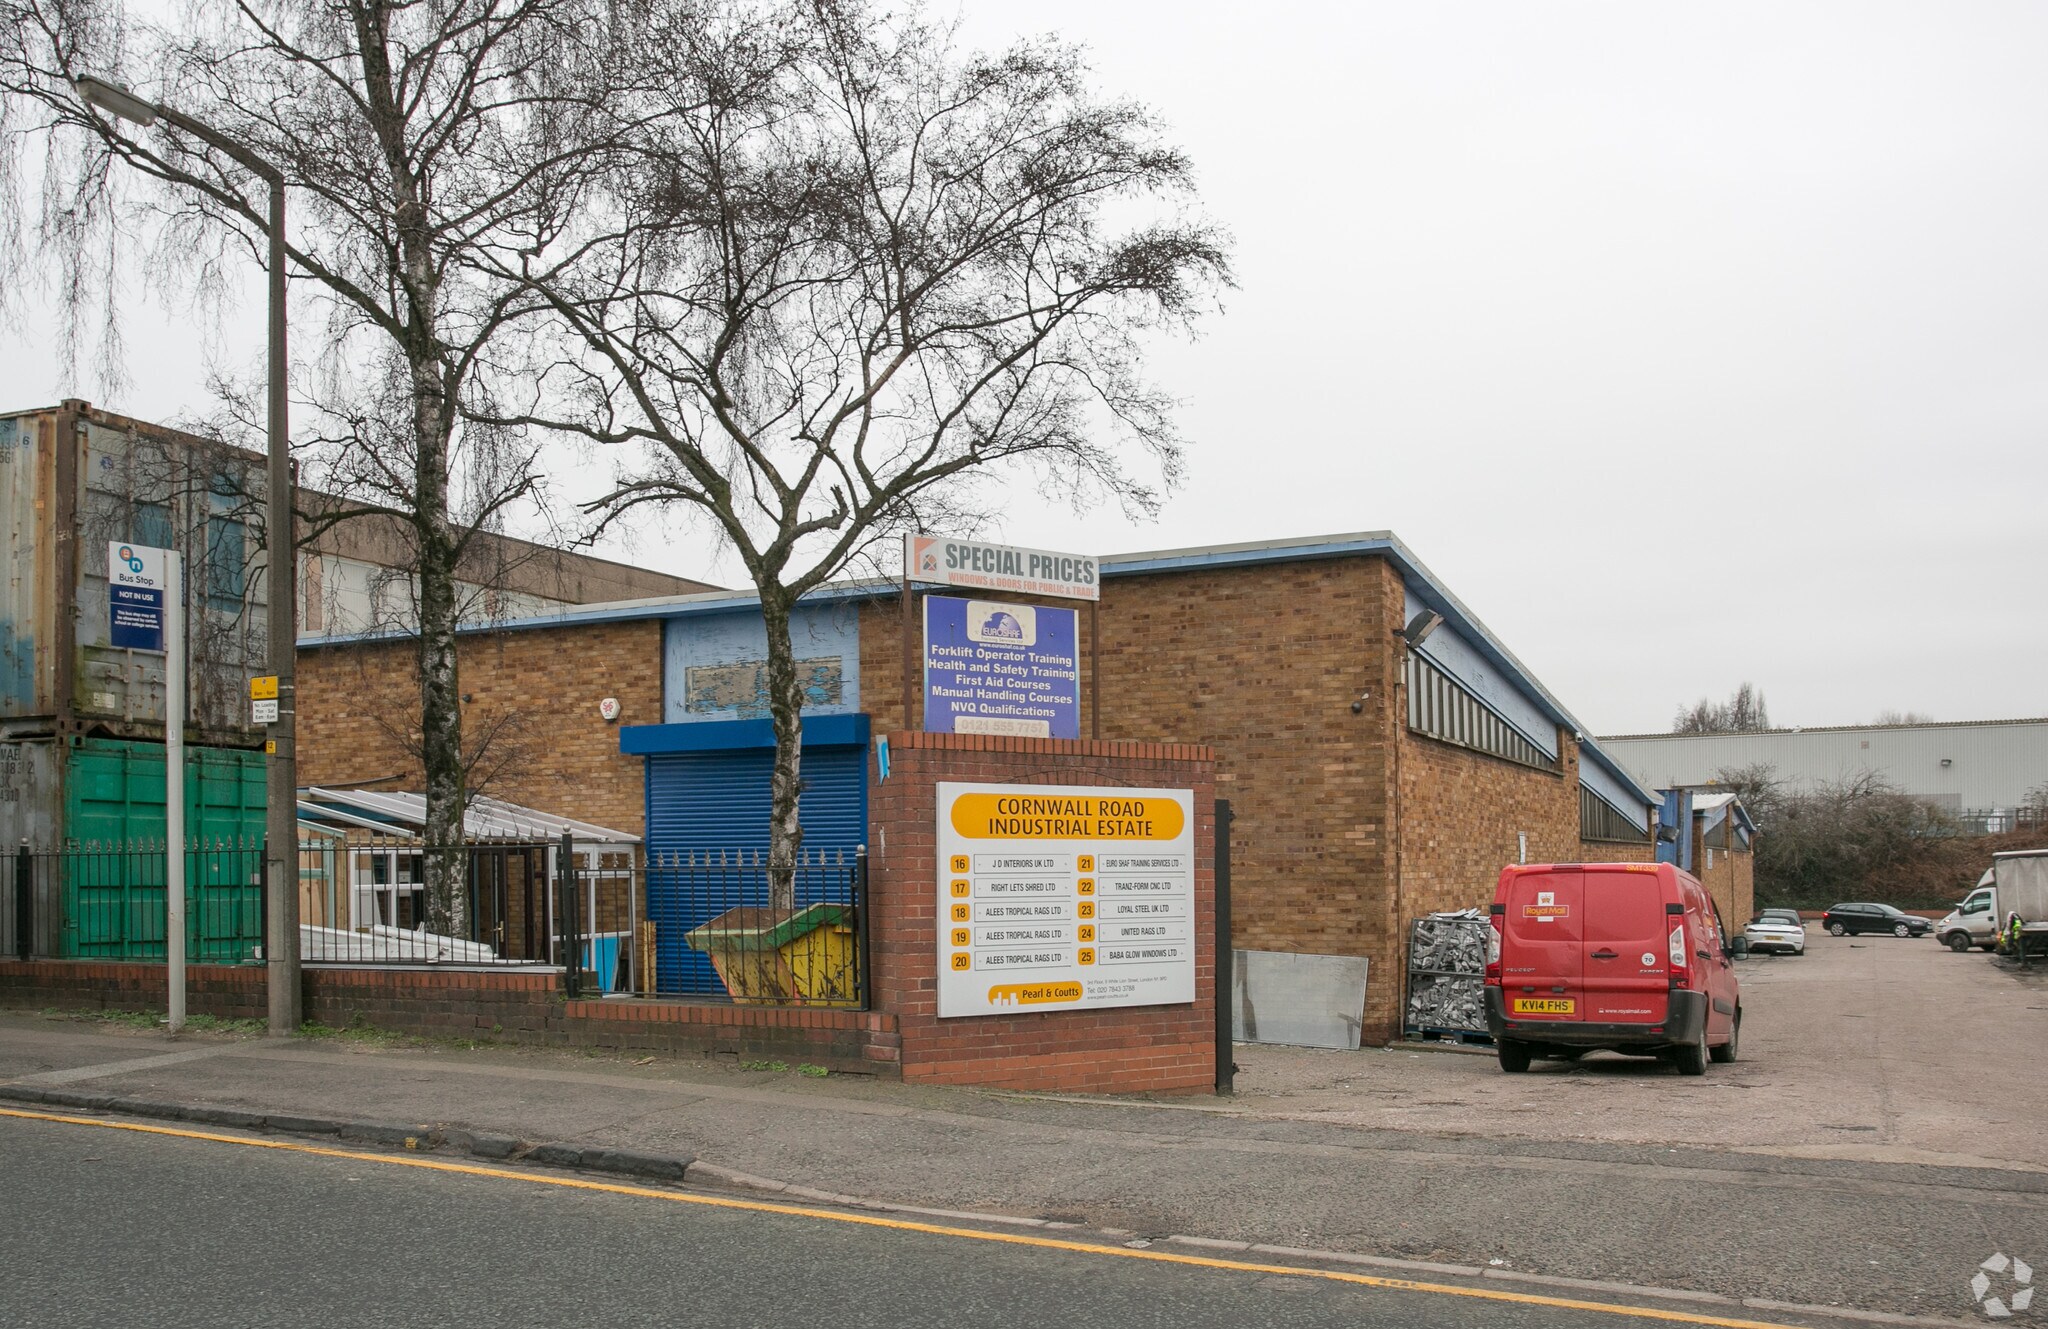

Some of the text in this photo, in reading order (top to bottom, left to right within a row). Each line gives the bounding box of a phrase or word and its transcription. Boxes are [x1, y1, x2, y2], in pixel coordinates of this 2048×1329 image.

[945, 543, 1095, 585] SPECIAL PRICES
[119, 573, 154, 586] Bus Stop
[948, 572, 1095, 598] WINDOWS & DOORS FOR PUBLIC & TRADE
[119, 591, 133, 599] NOT
[142, 594, 154, 602] USE
[979, 642, 1026, 651] www.euroshaf.co.uk
[931, 644, 1072, 668] Forklift Operator Training
[928, 658, 1076, 681] Health and Safety Training
[956, 674, 1051, 690] First Aid Courses
[932, 686, 1073, 704] Manual Handling Courses
[951, 701, 1056, 717] NVQ Qualifications
[961, 719, 1045, 733] 0121 555 7757
[997, 798, 1145, 817] CORNWALL ROAD
[989, 818, 1153, 837] INDUSTRIAL ESTATE
[955, 859, 966, 869] 16
[992, 859, 1054, 868] J D INTERIORS UK LTD
[1081, 859, 1091, 869] 21
[1106, 859, 1179, 867] EURO SHAF TRAINING SERVICES LTD
[955, 883, 965, 894] 17
[991, 883, 1056, 892] RIGHT LETS SHRED LTD
[1081, 882, 1091, 892] 22
[1115, 882, 1171, 890] TRANZ-FORM CNC LTD
[955, 907, 966, 918] 18
[985, 906, 1061, 916] ALEES TROPICAL RAGS LTD
[1081, 905, 1092, 915] 23
[1117, 904, 1169, 913] LOYAL STEEL UK LTD
[1526, 907, 1566, 916] Royal Mail
[955, 932, 966, 942] 19
[986, 930, 1062, 940] ALEES TROPICAL RAGS LTD
[1081, 928, 1091, 939] 24
[1121, 927, 1166, 936] UNITED RAGS LTD
[985, 953, 1062, 965] ALEES TROPICAL RAGS LTD
[1081, 952, 1092, 962] 25
[1109, 949, 1177, 960] BABA GLOW WINDOWS LTD
[955, 956, 967, 967] 20
[1022, 987, 1079, 999] Pearl & Coutts
[1096, 986, 1108, 994] 020
[1108, 985, 1121, 993] 7843
[1122, 984, 1135, 992] 3788
[1521, 1000, 1569, 1012] KV14 FHS
